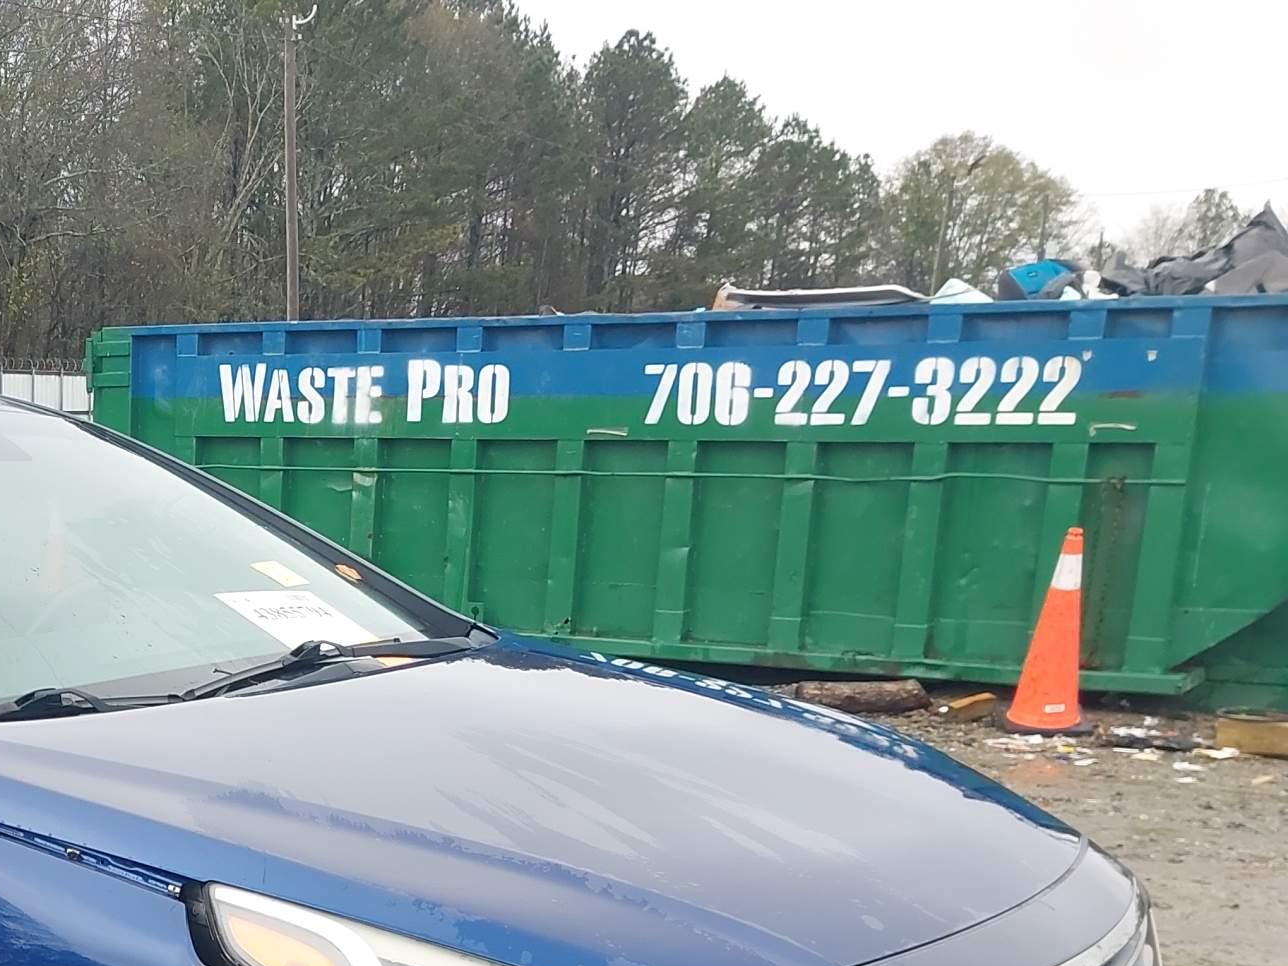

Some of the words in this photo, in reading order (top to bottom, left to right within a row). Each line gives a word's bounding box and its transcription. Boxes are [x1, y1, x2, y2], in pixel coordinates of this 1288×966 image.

[218, 362, 385, 424] WASTE
[406, 358, 511, 424] PRO
[643, 355, 1083, 426] 706-227-3222
